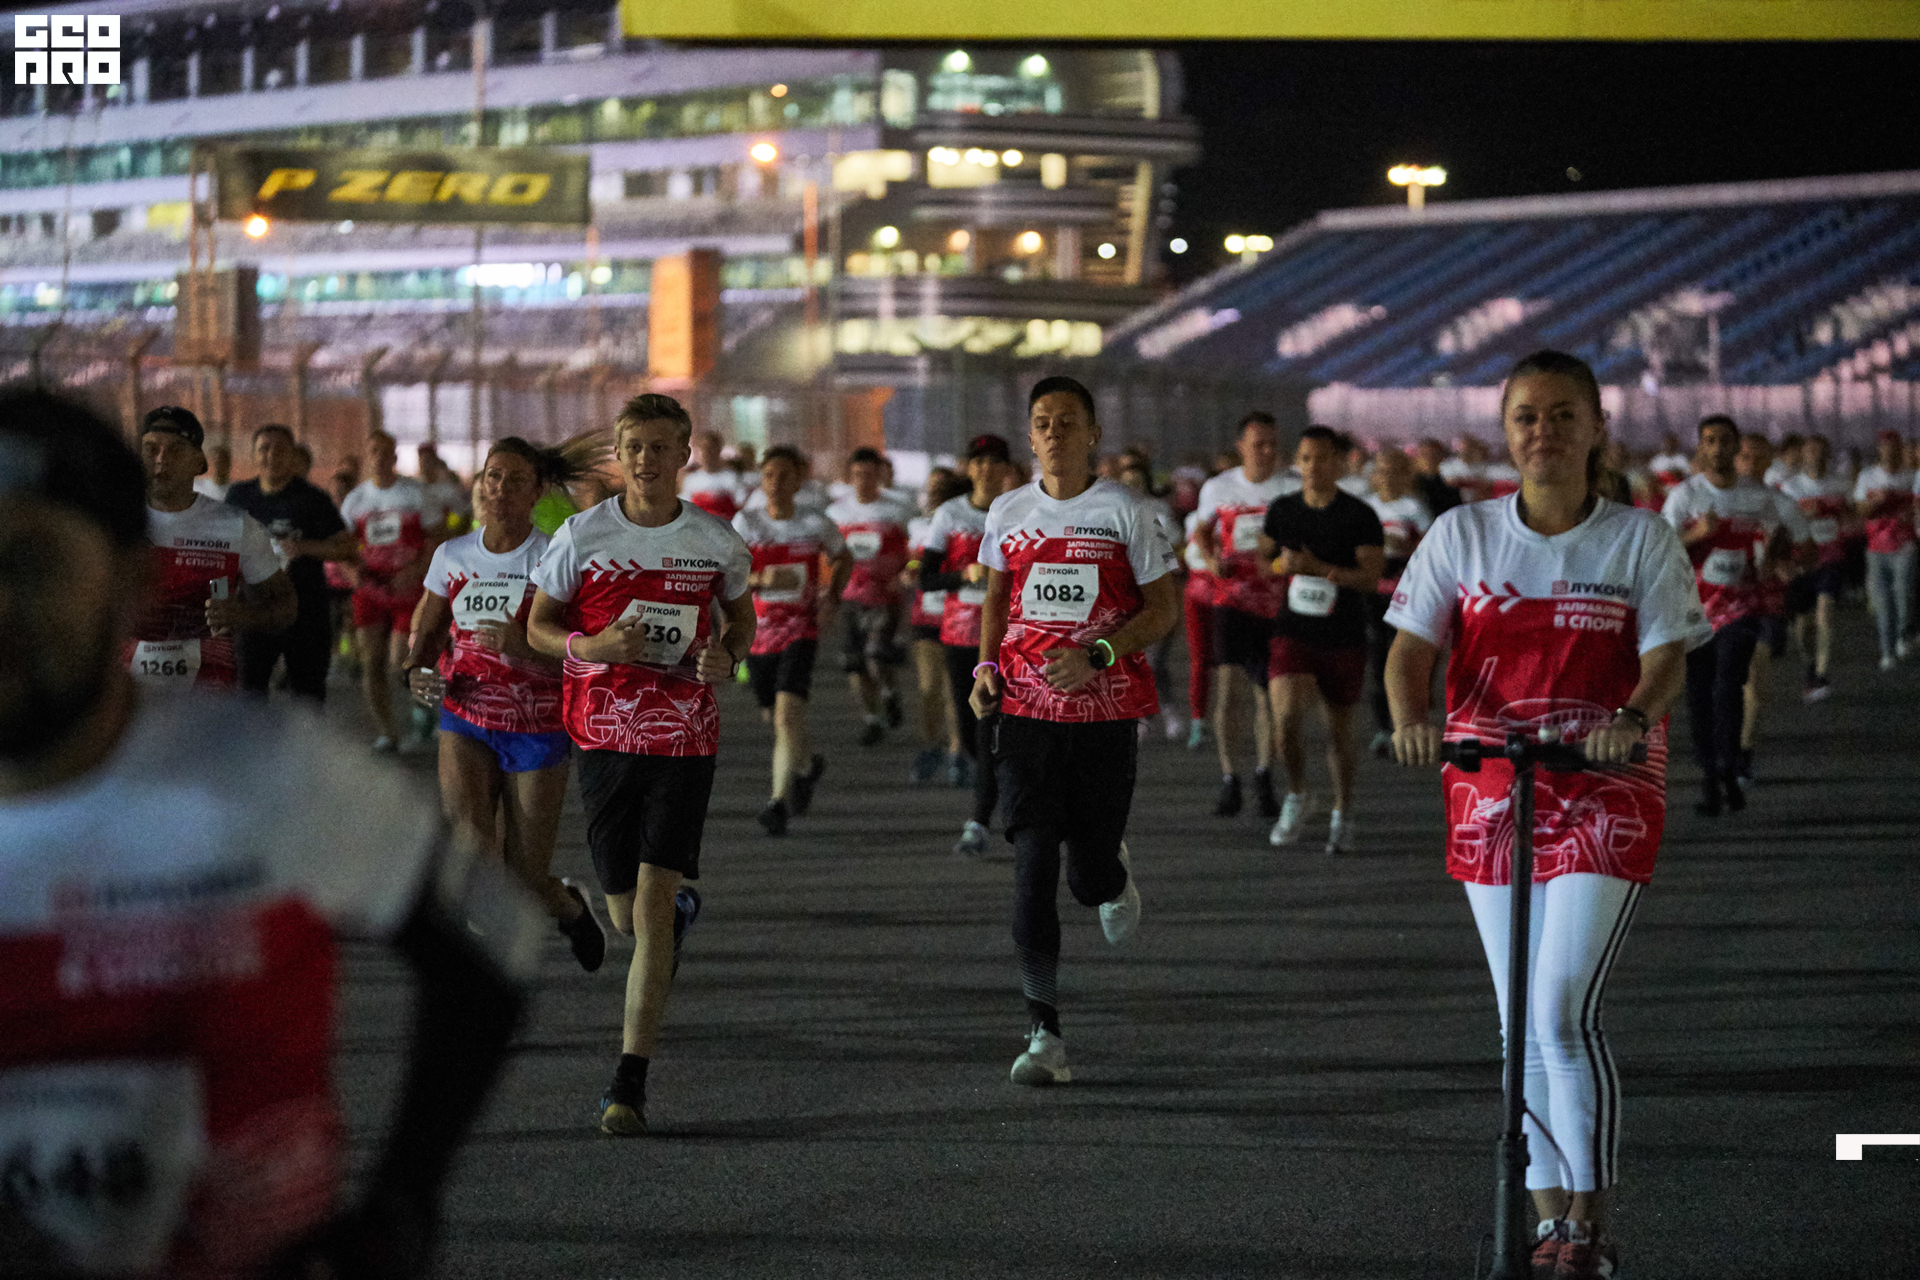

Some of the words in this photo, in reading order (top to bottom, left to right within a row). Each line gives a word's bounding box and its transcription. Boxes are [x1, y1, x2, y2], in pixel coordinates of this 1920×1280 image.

[257, 168, 318, 201] P
[328, 169, 551, 205] ZERO
[1075, 527, 1120, 539] ЛУКОЙЛ
[185, 538, 231, 549] ЛУКОЙЛ
[1065, 549, 1073, 557] В
[1074, 549, 1115, 560] СПОРТЕ
[673, 558, 720, 569] ЛУКОЙЛ
[1046, 568, 1080, 576] ЛУКОЙЛ
[664, 581, 672, 590] В
[1033, 584, 1085, 602] 1082
[463, 595, 510, 612] 1807
[645, 606, 681, 617] ЛУКОЙЛ
[1553, 614, 1566, 628] В
[140, 659, 188, 676] 1266
